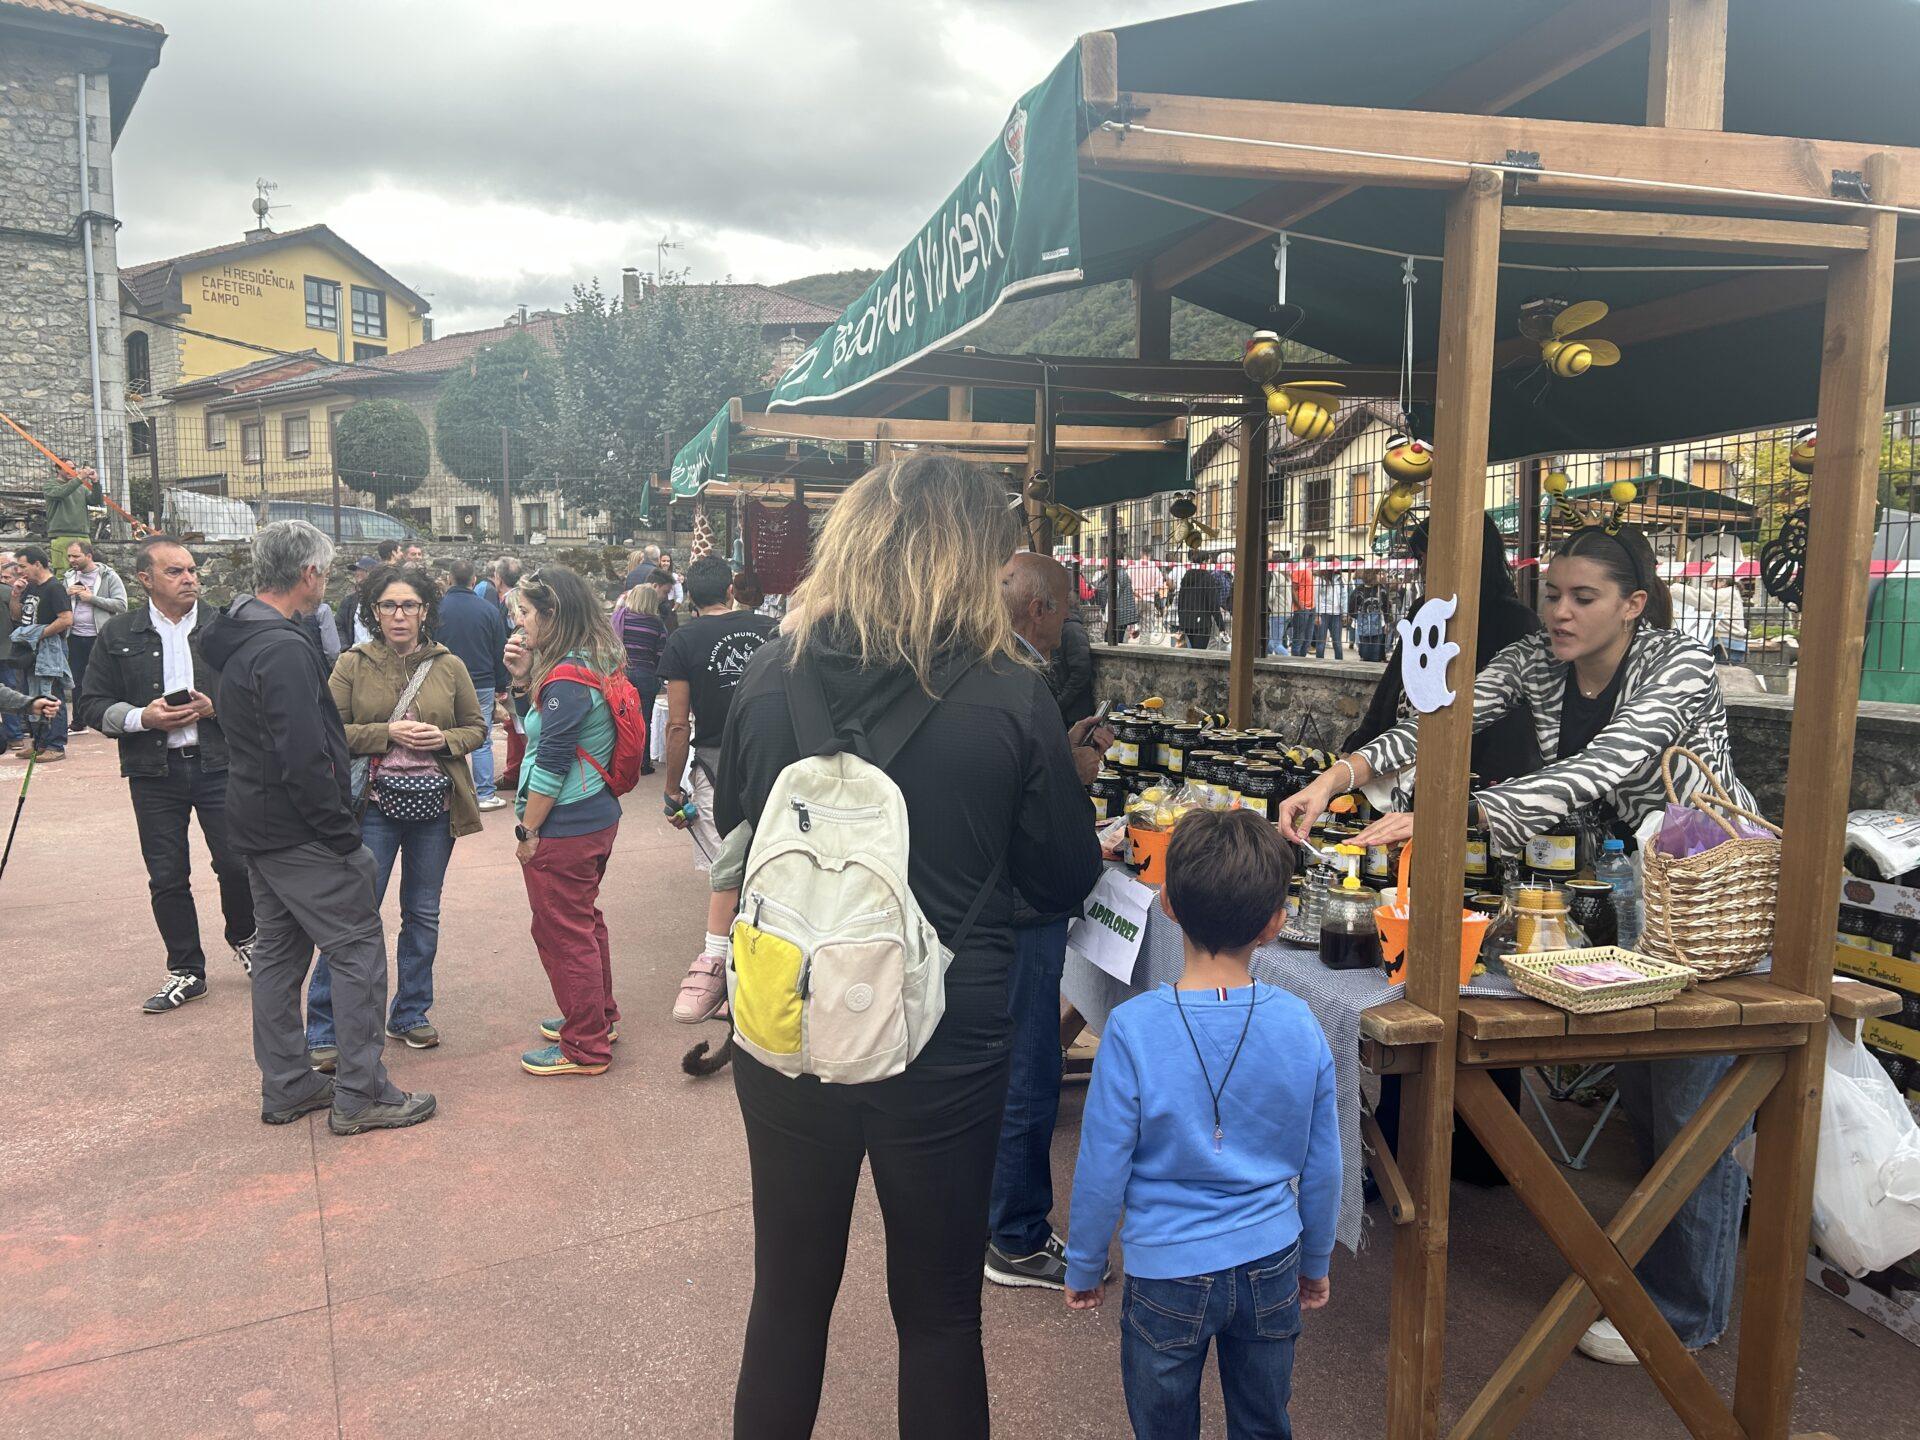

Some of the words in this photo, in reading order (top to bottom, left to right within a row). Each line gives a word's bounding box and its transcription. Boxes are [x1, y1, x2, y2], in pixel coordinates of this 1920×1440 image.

[202, 275, 263, 298] CAFETERIA
[223, 266, 231, 278] H
[233, 268, 295, 291] RESIDENCIA
[202, 289, 240, 307] CAMPO
[887, 258, 915, 336] de
[1087, 902, 1140, 943] APIFLOREZ
[1868, 966, 1902, 984] Melinda
